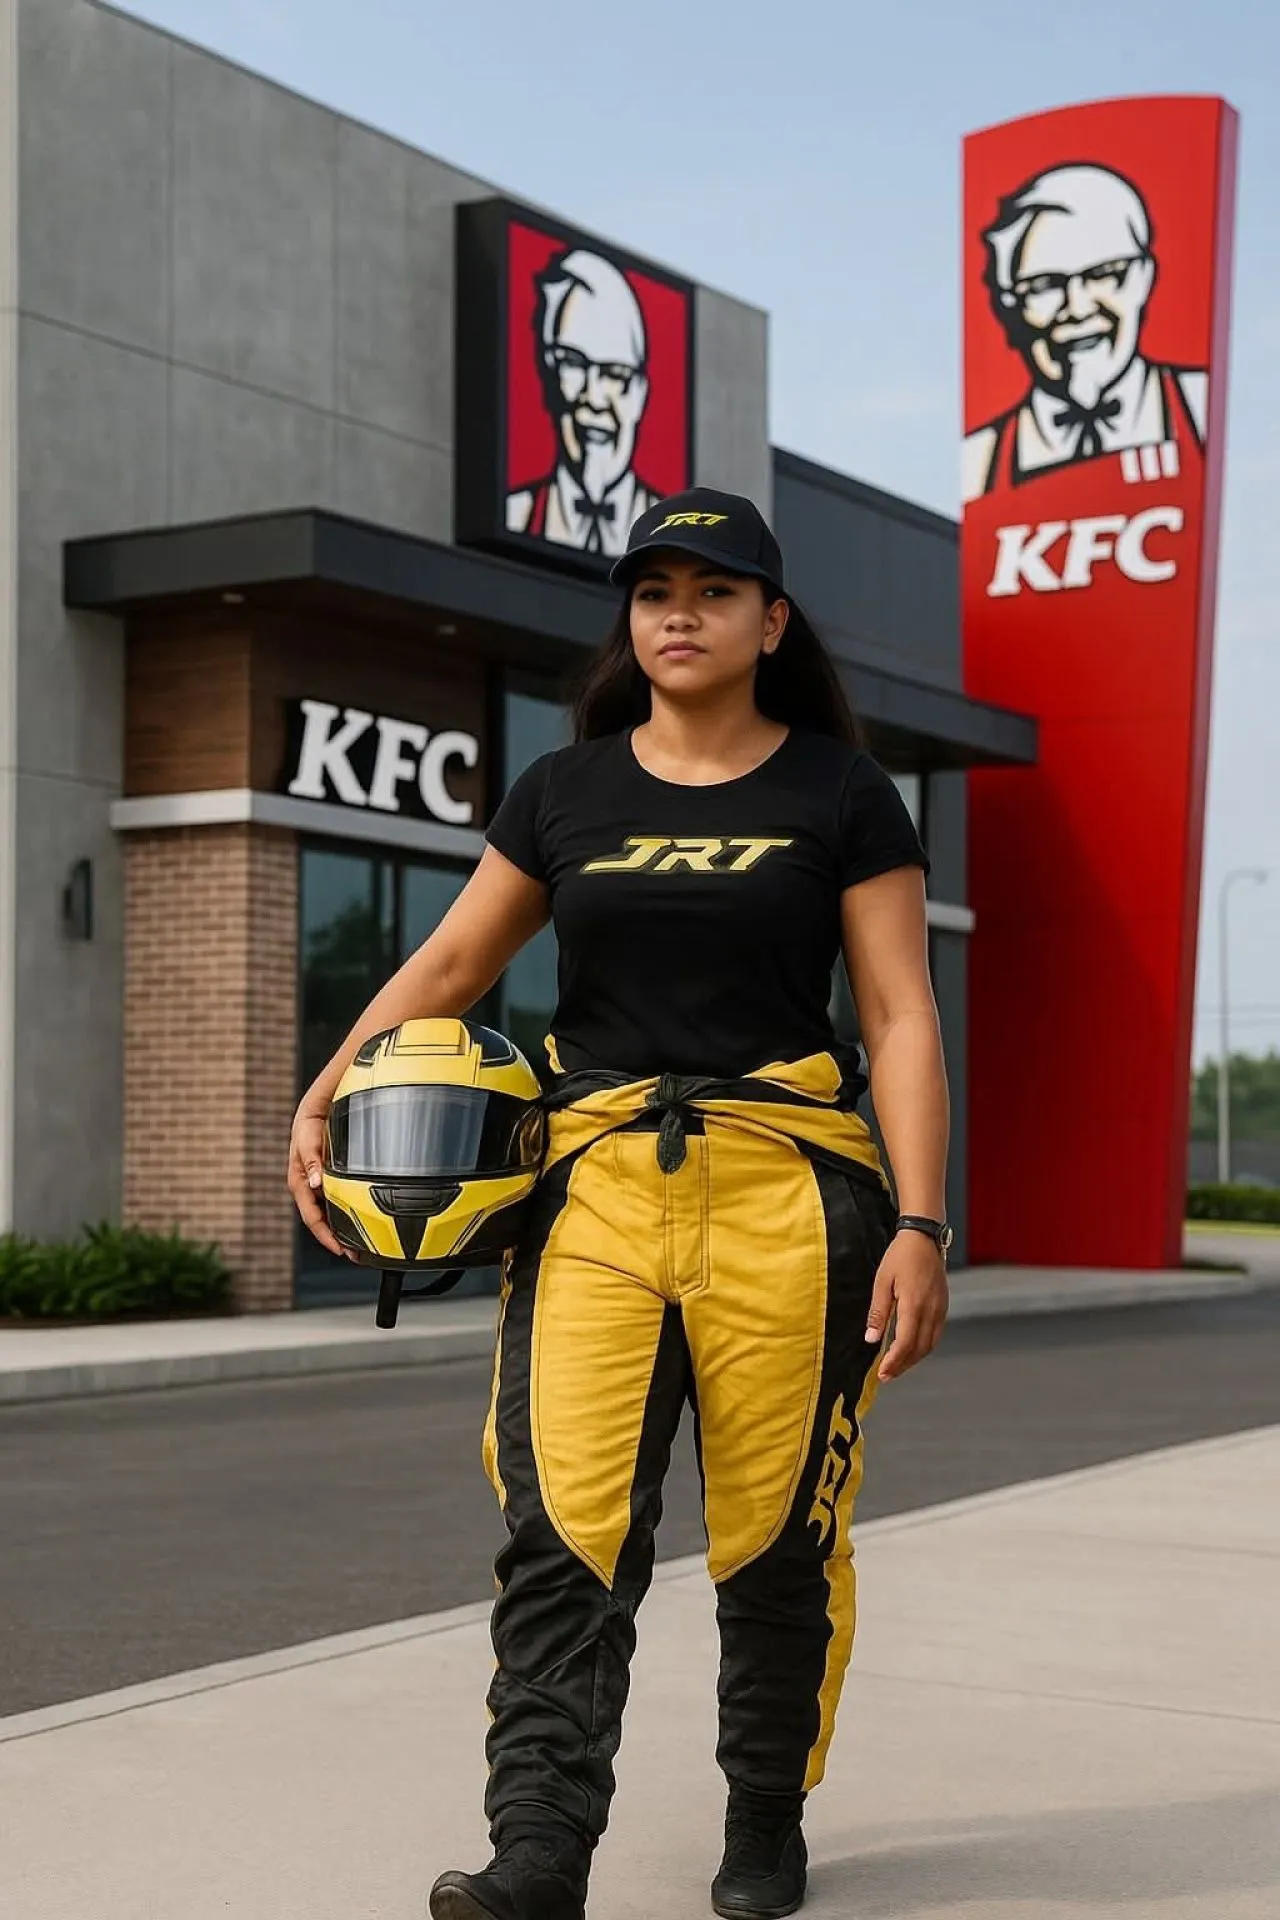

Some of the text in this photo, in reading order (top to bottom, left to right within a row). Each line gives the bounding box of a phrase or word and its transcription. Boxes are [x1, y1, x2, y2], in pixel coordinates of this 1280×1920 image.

[650, 511, 729, 535] JRT
[986, 506, 1184, 598] KFC
[288, 699, 478, 824] KFC
[582, 836, 794, 874] JRT
